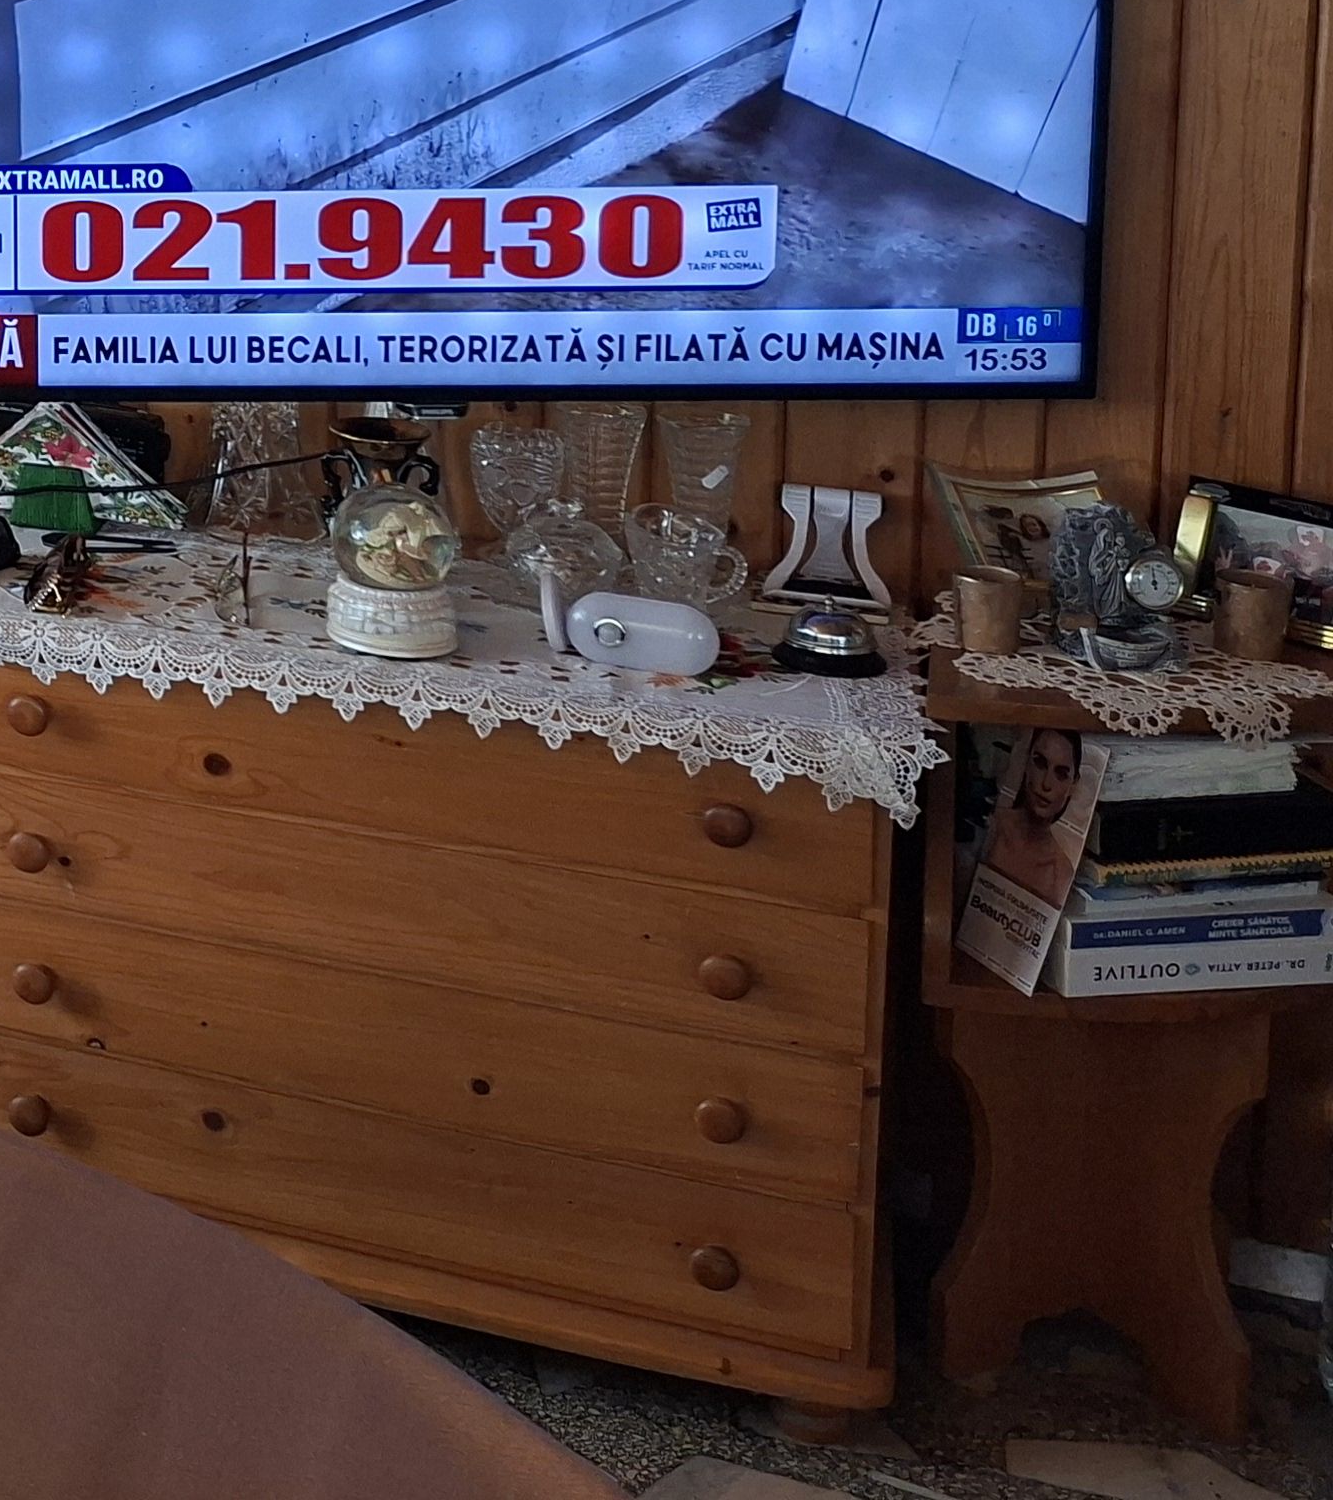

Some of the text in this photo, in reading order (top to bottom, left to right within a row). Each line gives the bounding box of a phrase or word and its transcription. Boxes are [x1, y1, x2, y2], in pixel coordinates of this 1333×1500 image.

[709, 201, 758, 217] EXTRA
[710, 213, 759, 230] MALL
[41, 193, 684, 283] 021.9430
[704, 250, 749, 259] APEL CU
[687, 262, 764, 271] TARIF NORMAL
[965, 312, 996, 337] DB
[52, 326, 945, 371] FAMILIA LUI BECALI, TERORIZATĂ ȘI FILATĂ CU MAȘINA
[964, 347, 1048, 372] 15:53
[970, 895, 1042, 948] BeautyCLUB
[1107, 929, 1144, 939] DANIEL
[1156, 926, 1186, 936] AMEN
[1208, 928, 1237, 939] MINTE
[1093, 961, 1181, 982] OUTLIVE
[1208, 958, 1305, 973] DR. PETER ATTIA
